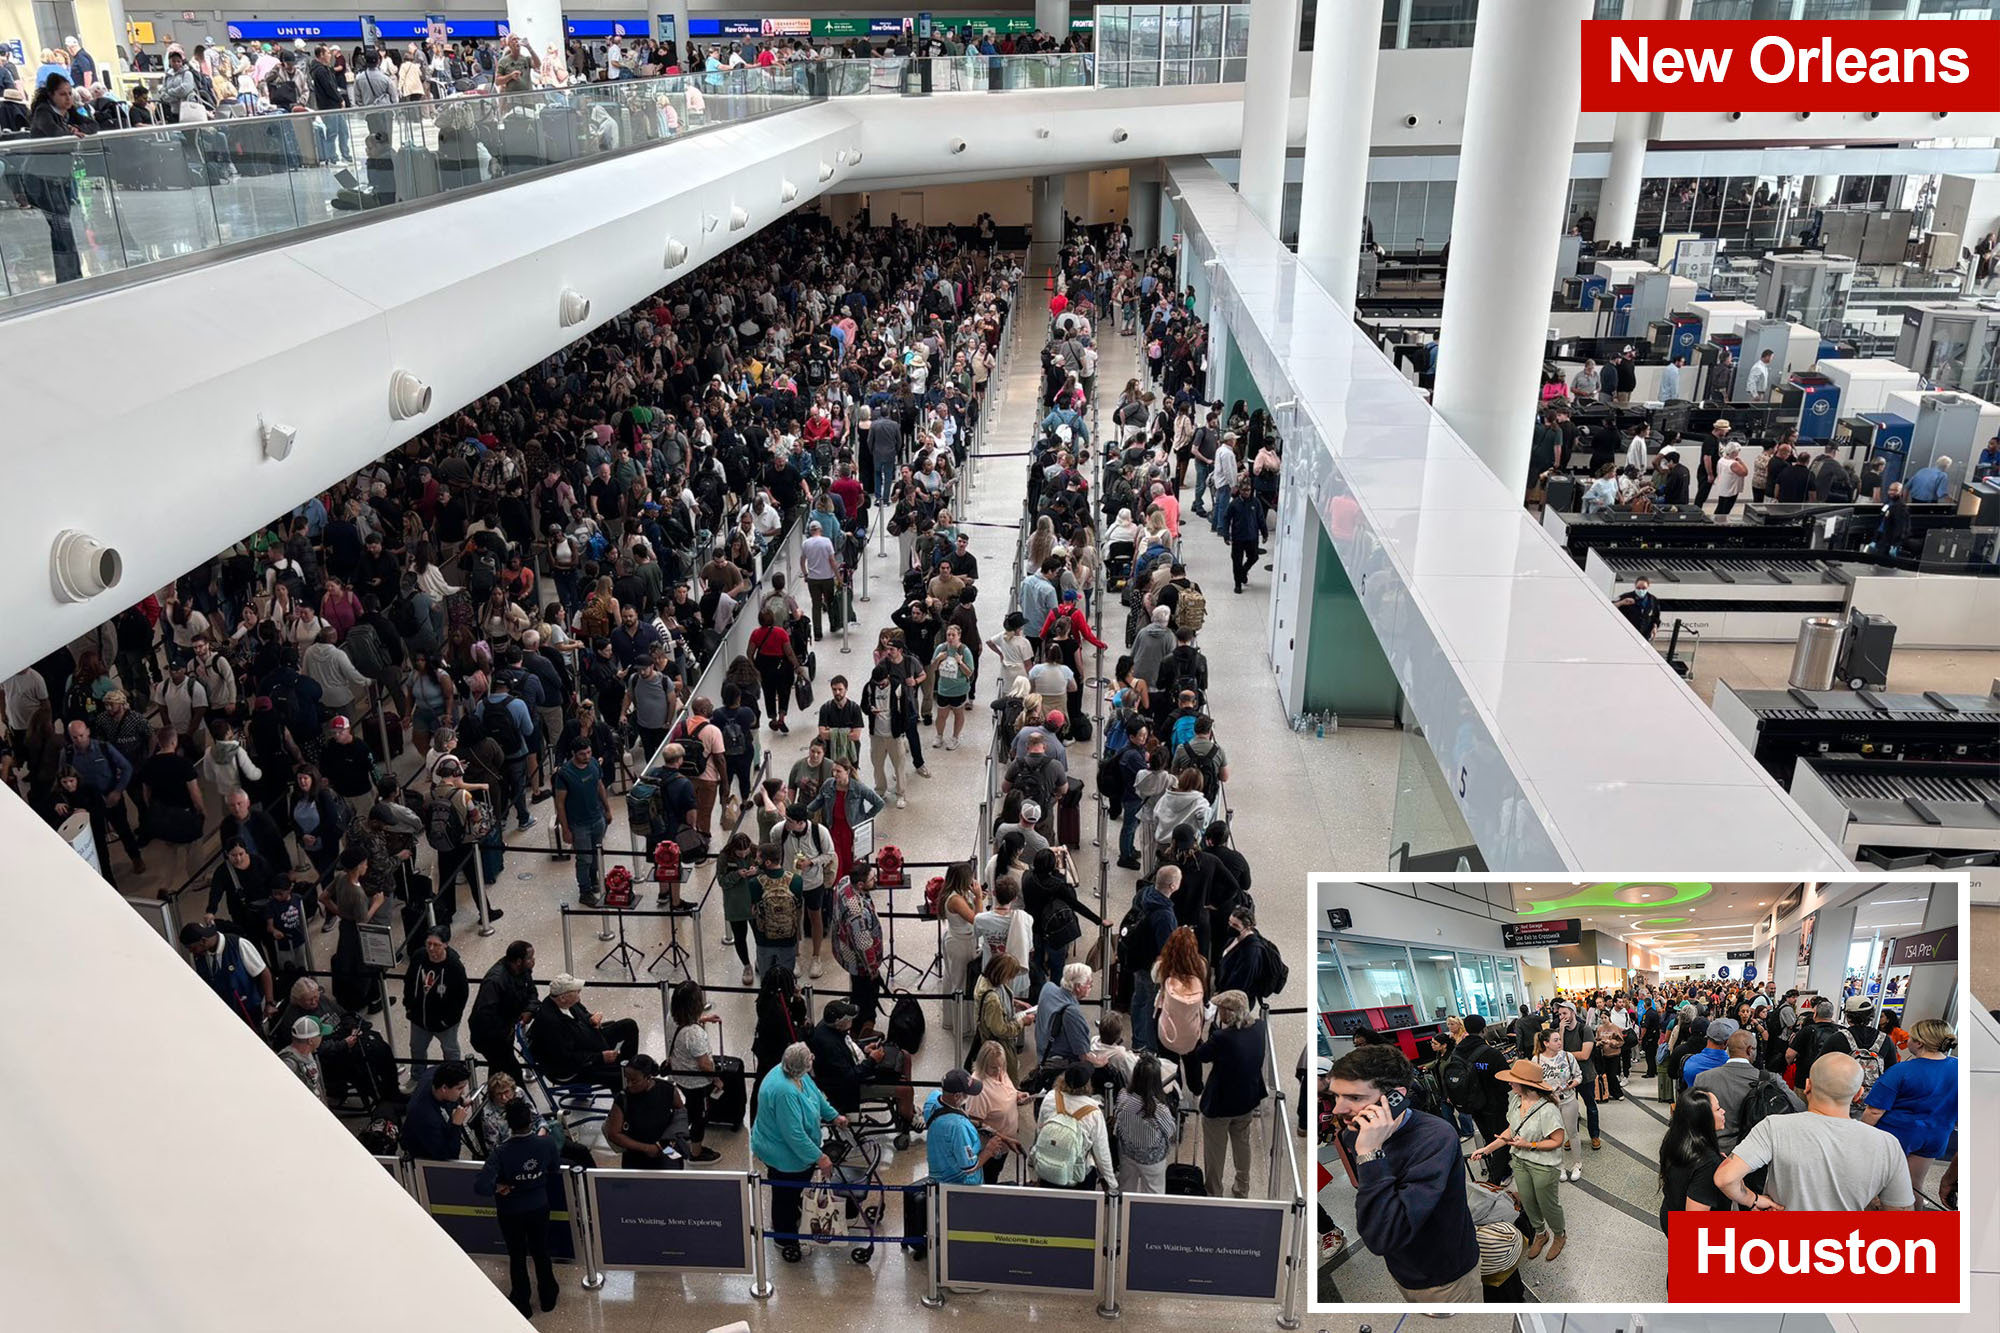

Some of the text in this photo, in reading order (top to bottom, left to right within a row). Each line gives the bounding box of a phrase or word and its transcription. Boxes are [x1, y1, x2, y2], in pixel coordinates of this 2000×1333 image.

[1072, 20, 1094, 28] FRONTIE
[277, 27, 321, 36] UNITED
[1459, 765, 1467, 798] 5
[1904, 943, 1933, 959] TSA Pre
[474, 1208, 497, 1216] Welco
[620, 1216, 723, 1228] Less Waiting, More Exploring
[993, 1235, 1049, 1245] Welcome Back
[1145, 1242, 1261, 1258] Less Waiting, More Adventuring
